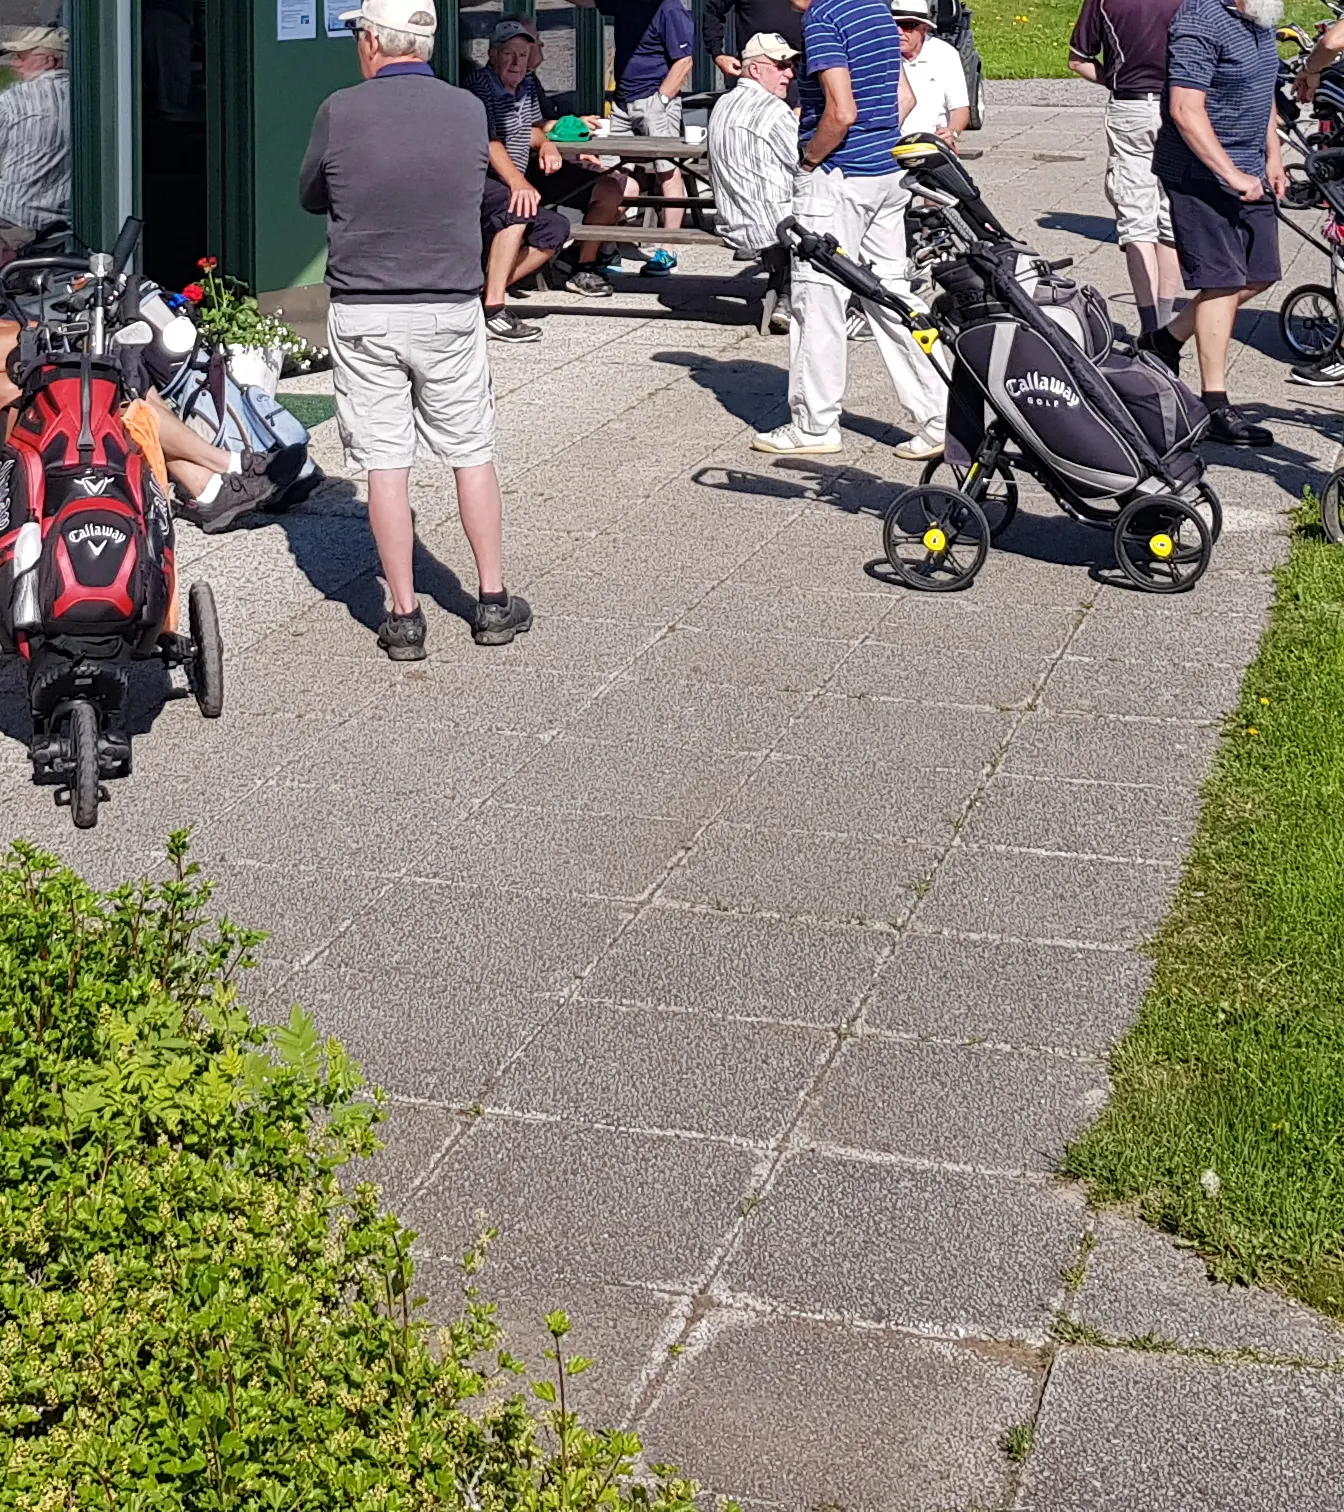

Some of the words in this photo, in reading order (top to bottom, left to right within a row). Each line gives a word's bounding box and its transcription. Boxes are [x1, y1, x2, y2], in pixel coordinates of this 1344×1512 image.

[1006, 370, 1080, 407] Callaway
[1027, 396, 1059, 408] GOLF
[68, 522, 127, 544] Callaway
